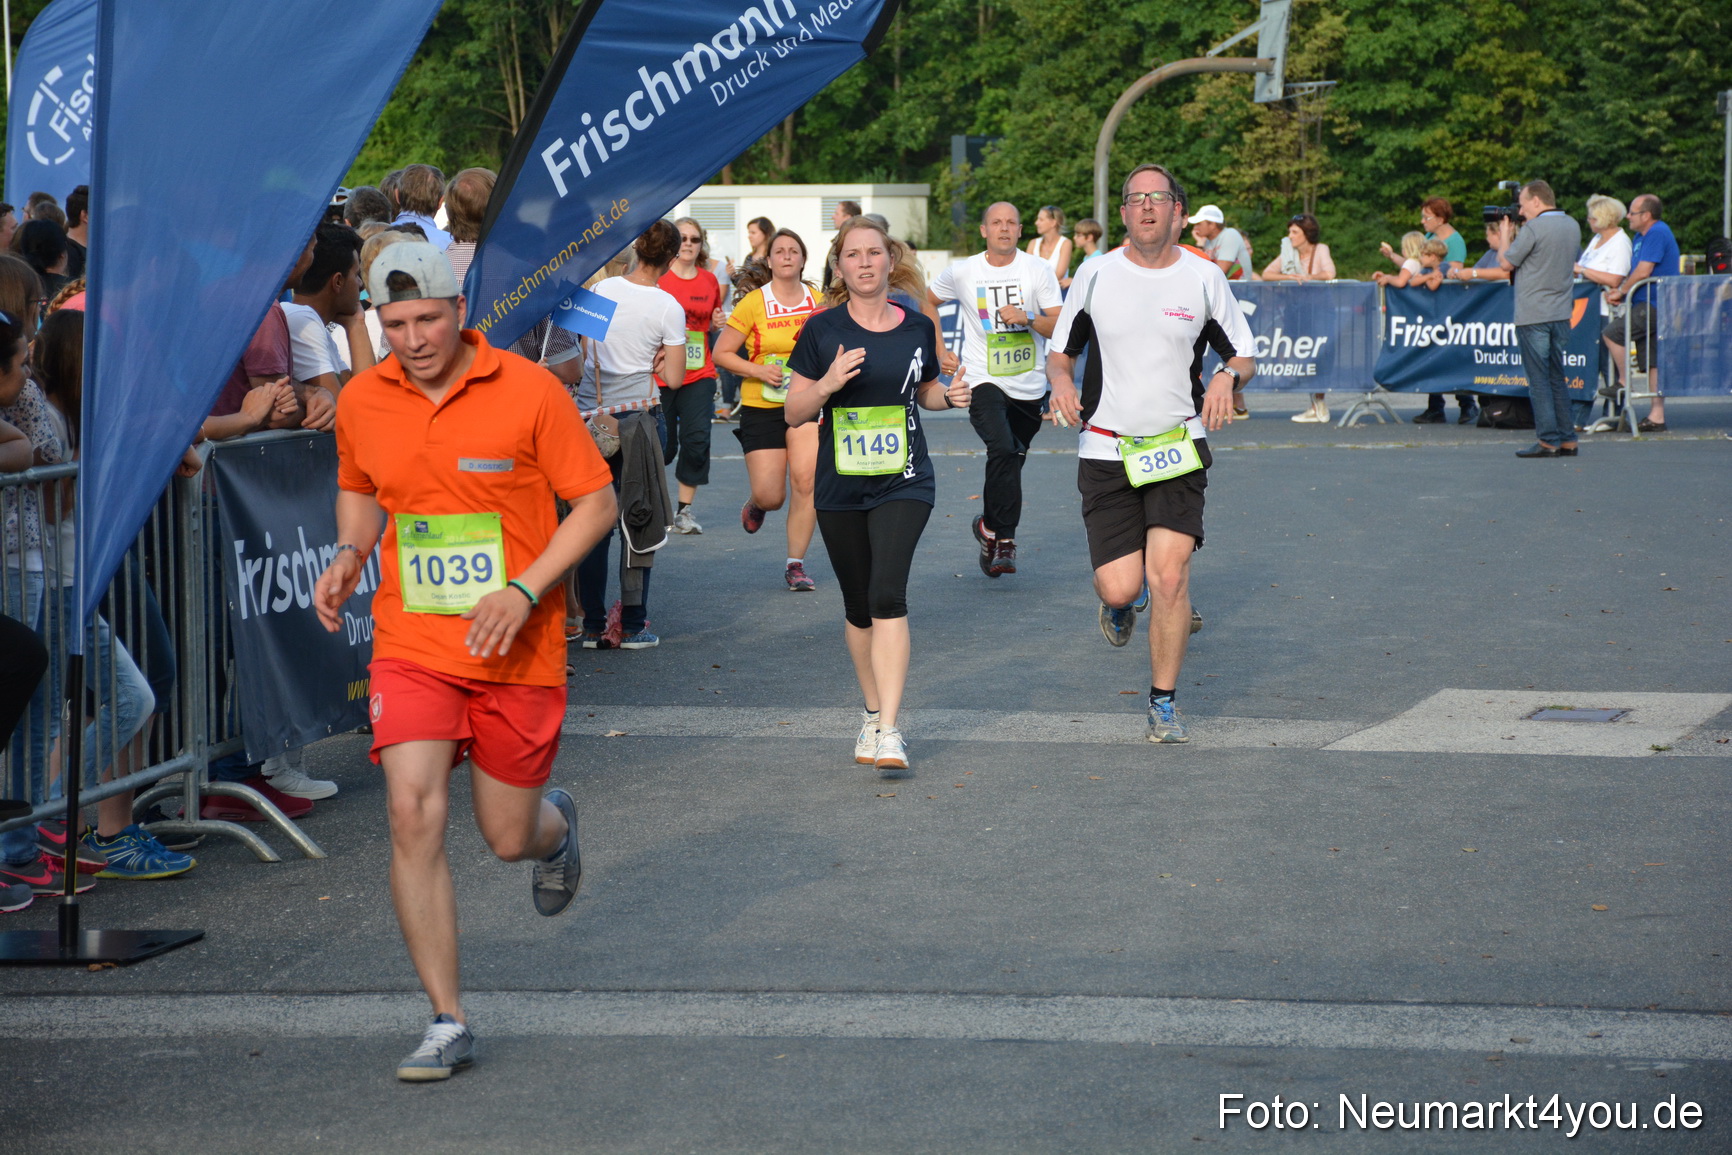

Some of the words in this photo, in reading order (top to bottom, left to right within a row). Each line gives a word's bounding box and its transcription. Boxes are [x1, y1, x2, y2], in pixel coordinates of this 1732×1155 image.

[710, 50, 771, 106] Druck
[773, 21, 814, 57] und
[573, 303, 609, 322] Lebenshilfe
[767, 320, 790, 330] MAX
[1390, 315, 1518, 347] Frischman
[993, 347, 1031, 365] 1166
[1474, 349, 1509, 365] Druck
[1562, 350, 1586, 367] ien
[842, 433, 899, 456] 1149
[1139, 448, 1182, 473] 380
[409, 552, 493, 586] 1039
[345, 611, 376, 646] Druc
